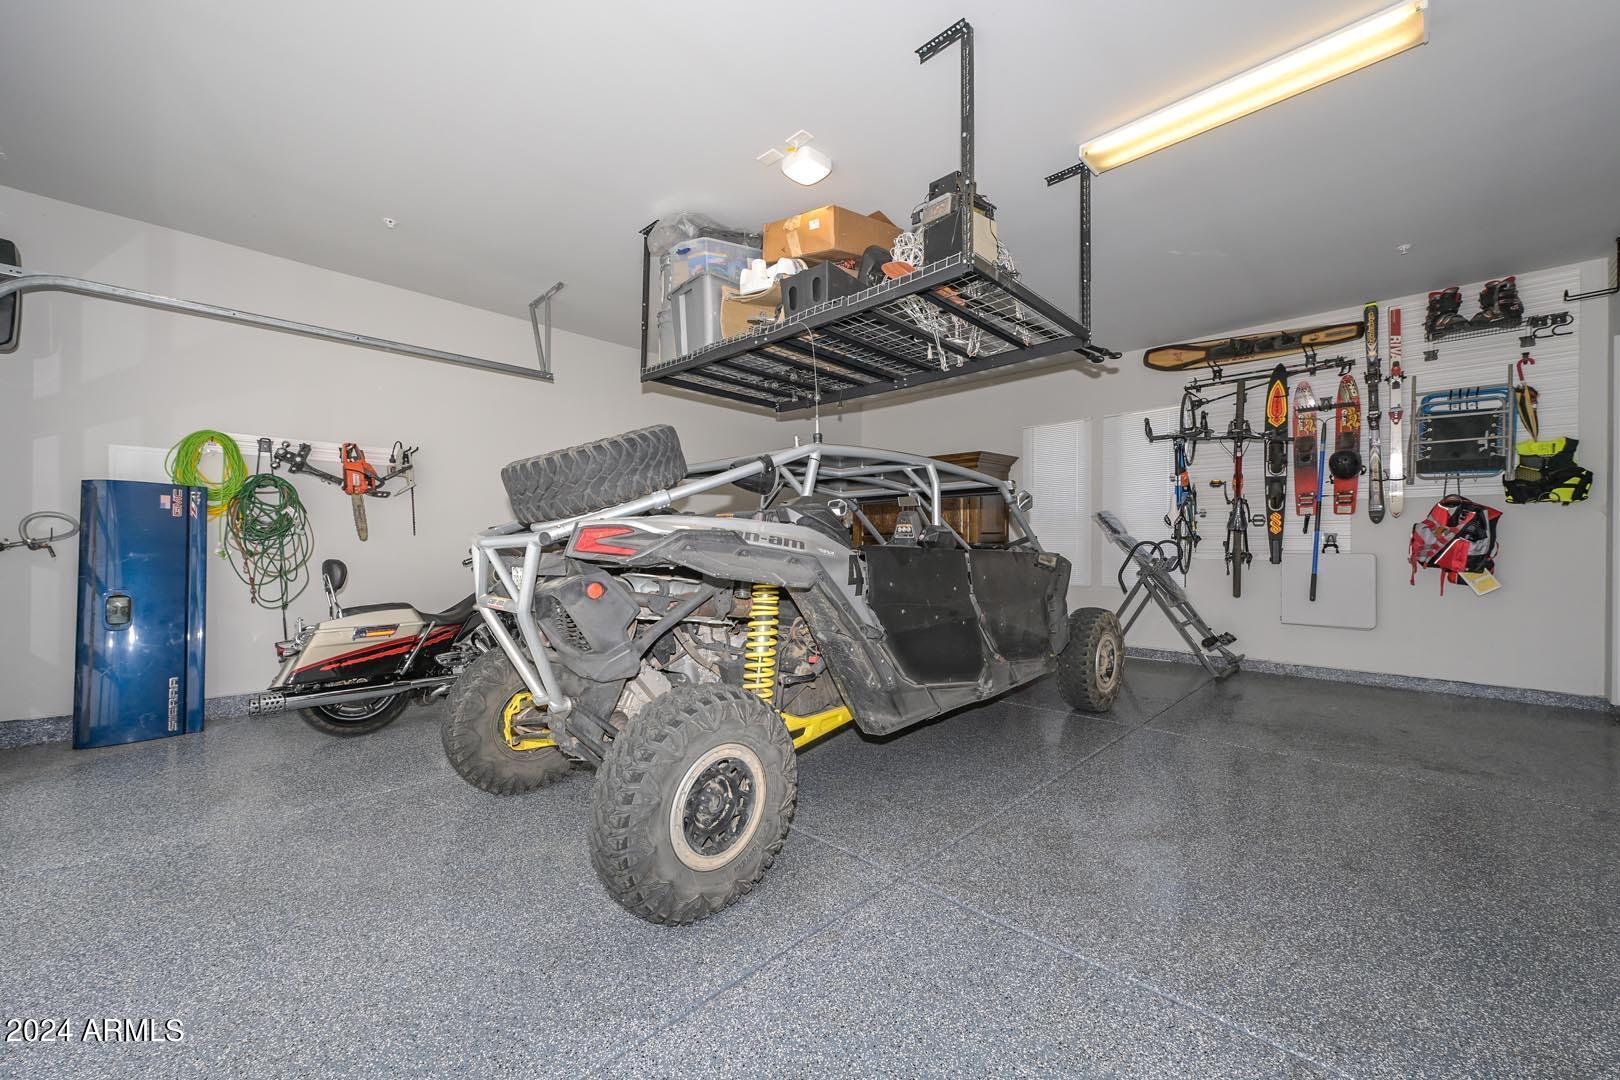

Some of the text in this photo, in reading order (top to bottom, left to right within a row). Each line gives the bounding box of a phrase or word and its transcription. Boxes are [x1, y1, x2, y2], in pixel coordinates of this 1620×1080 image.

[172, 489, 183, 516] GMC
[738, 530, 805, 550] n-am
[168, 677, 178, 731] SIERRA
